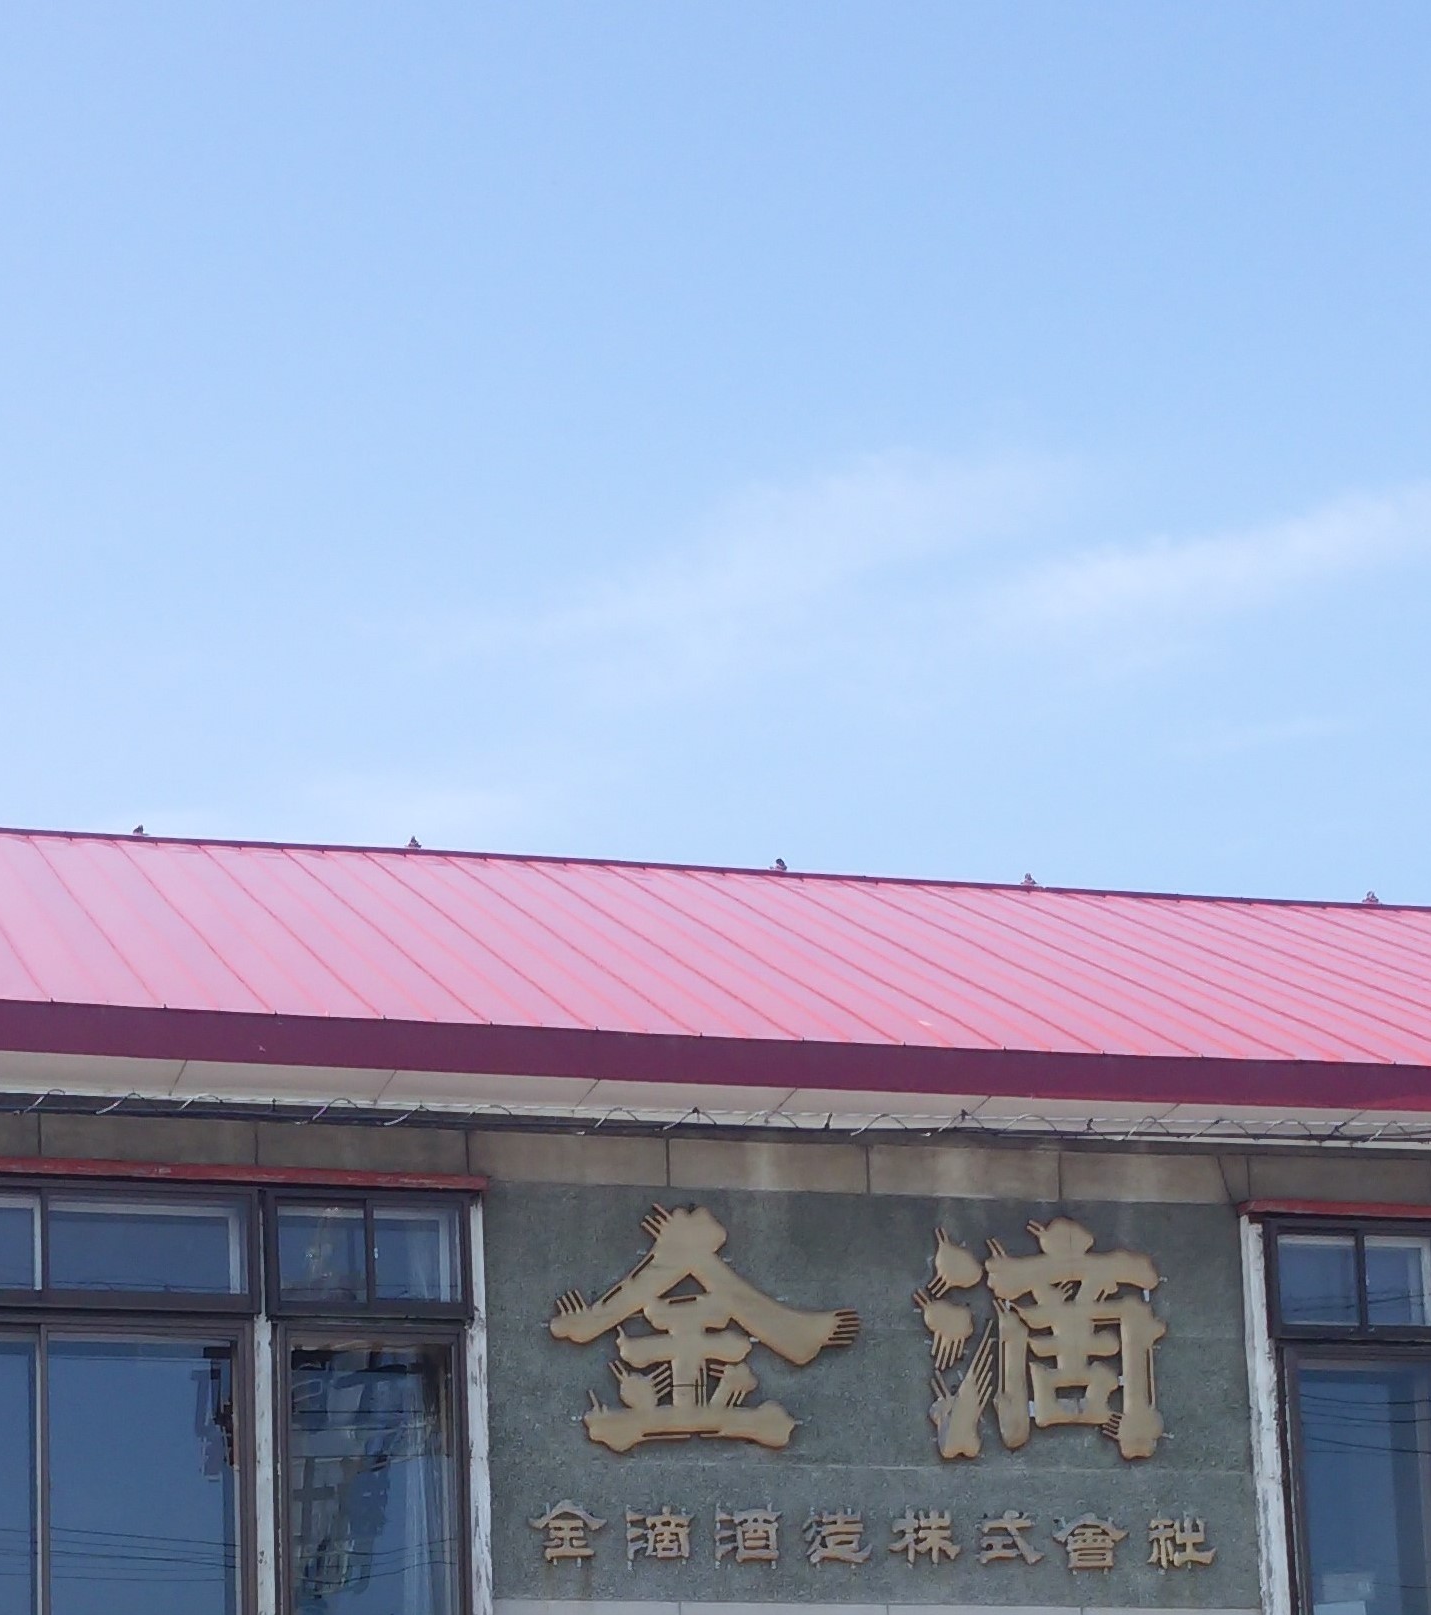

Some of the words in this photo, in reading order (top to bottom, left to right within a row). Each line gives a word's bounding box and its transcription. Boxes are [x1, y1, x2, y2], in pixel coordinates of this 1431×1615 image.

[550, 1202, 1168, 1460] 金滴
[529, 1498, 1216, 1570] 金滴酒造株式會社
